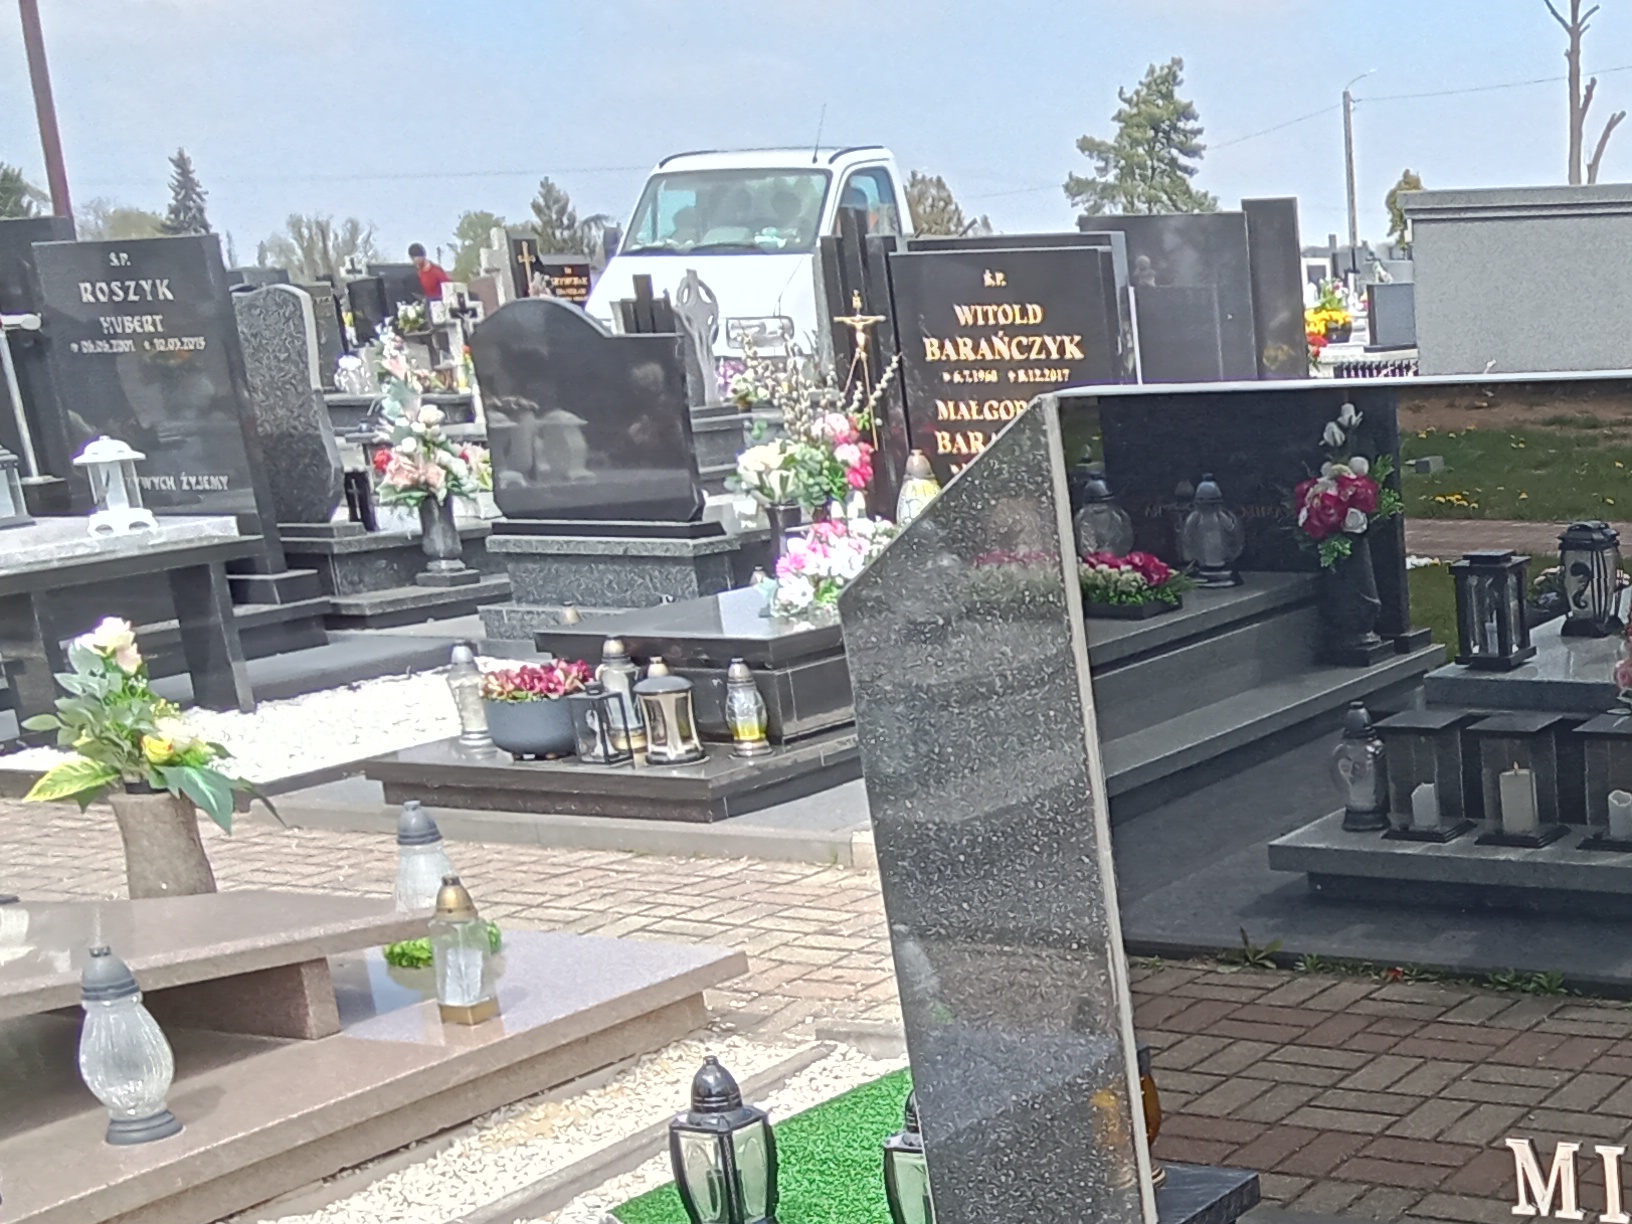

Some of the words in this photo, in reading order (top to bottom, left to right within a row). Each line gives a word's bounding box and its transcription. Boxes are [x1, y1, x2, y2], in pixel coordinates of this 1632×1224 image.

[78, 278, 175, 303] ROSZYK
[953, 303, 1044, 327] WITOLD
[923, 331, 1085, 362] BARAŃCZYK
